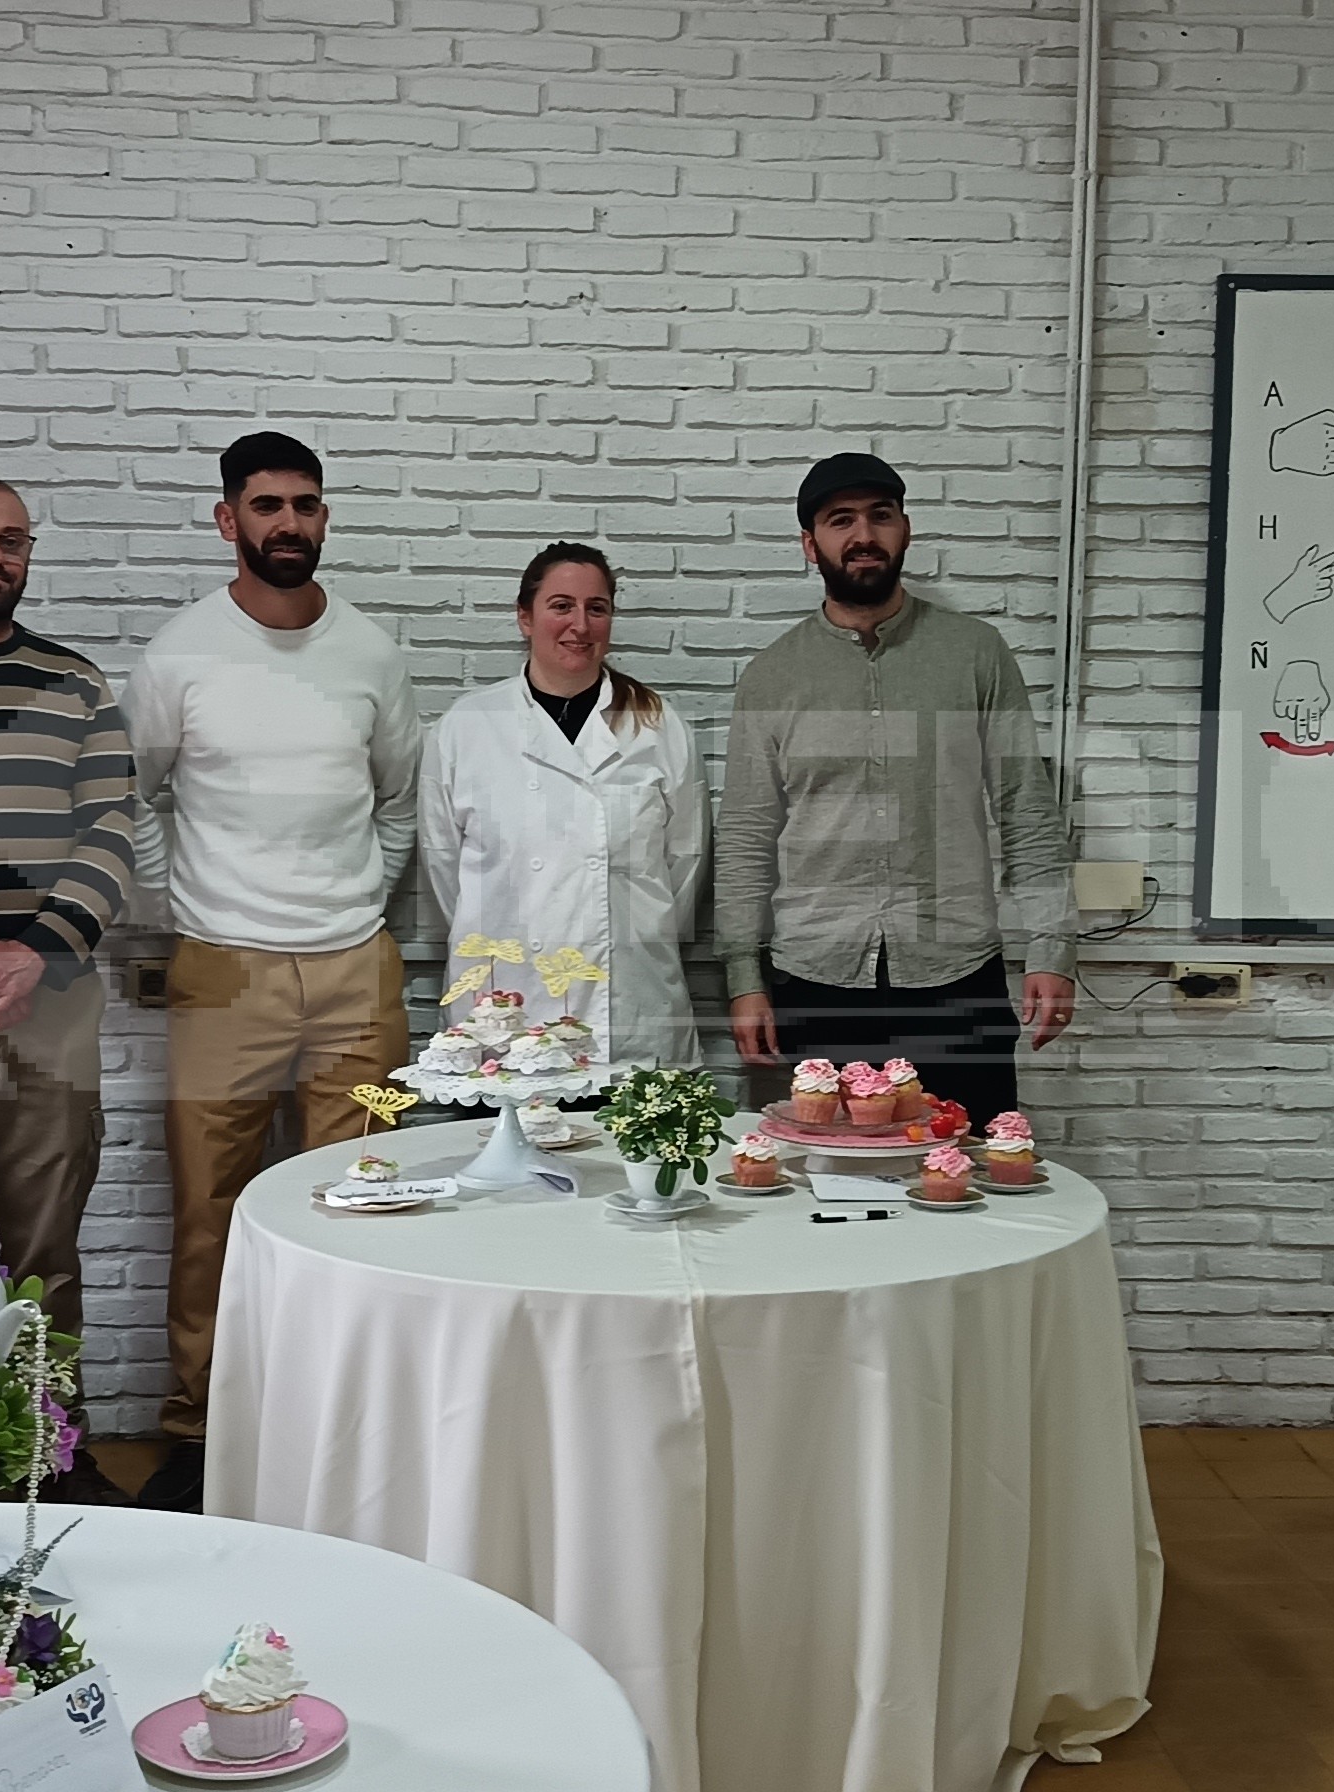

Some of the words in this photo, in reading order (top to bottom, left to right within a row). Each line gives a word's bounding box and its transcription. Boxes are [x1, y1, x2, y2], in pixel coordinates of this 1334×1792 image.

[1263, 380, 1284, 408] A
[1258, 514, 1277, 540] H
[1250, 640, 1268, 670] Ñ
